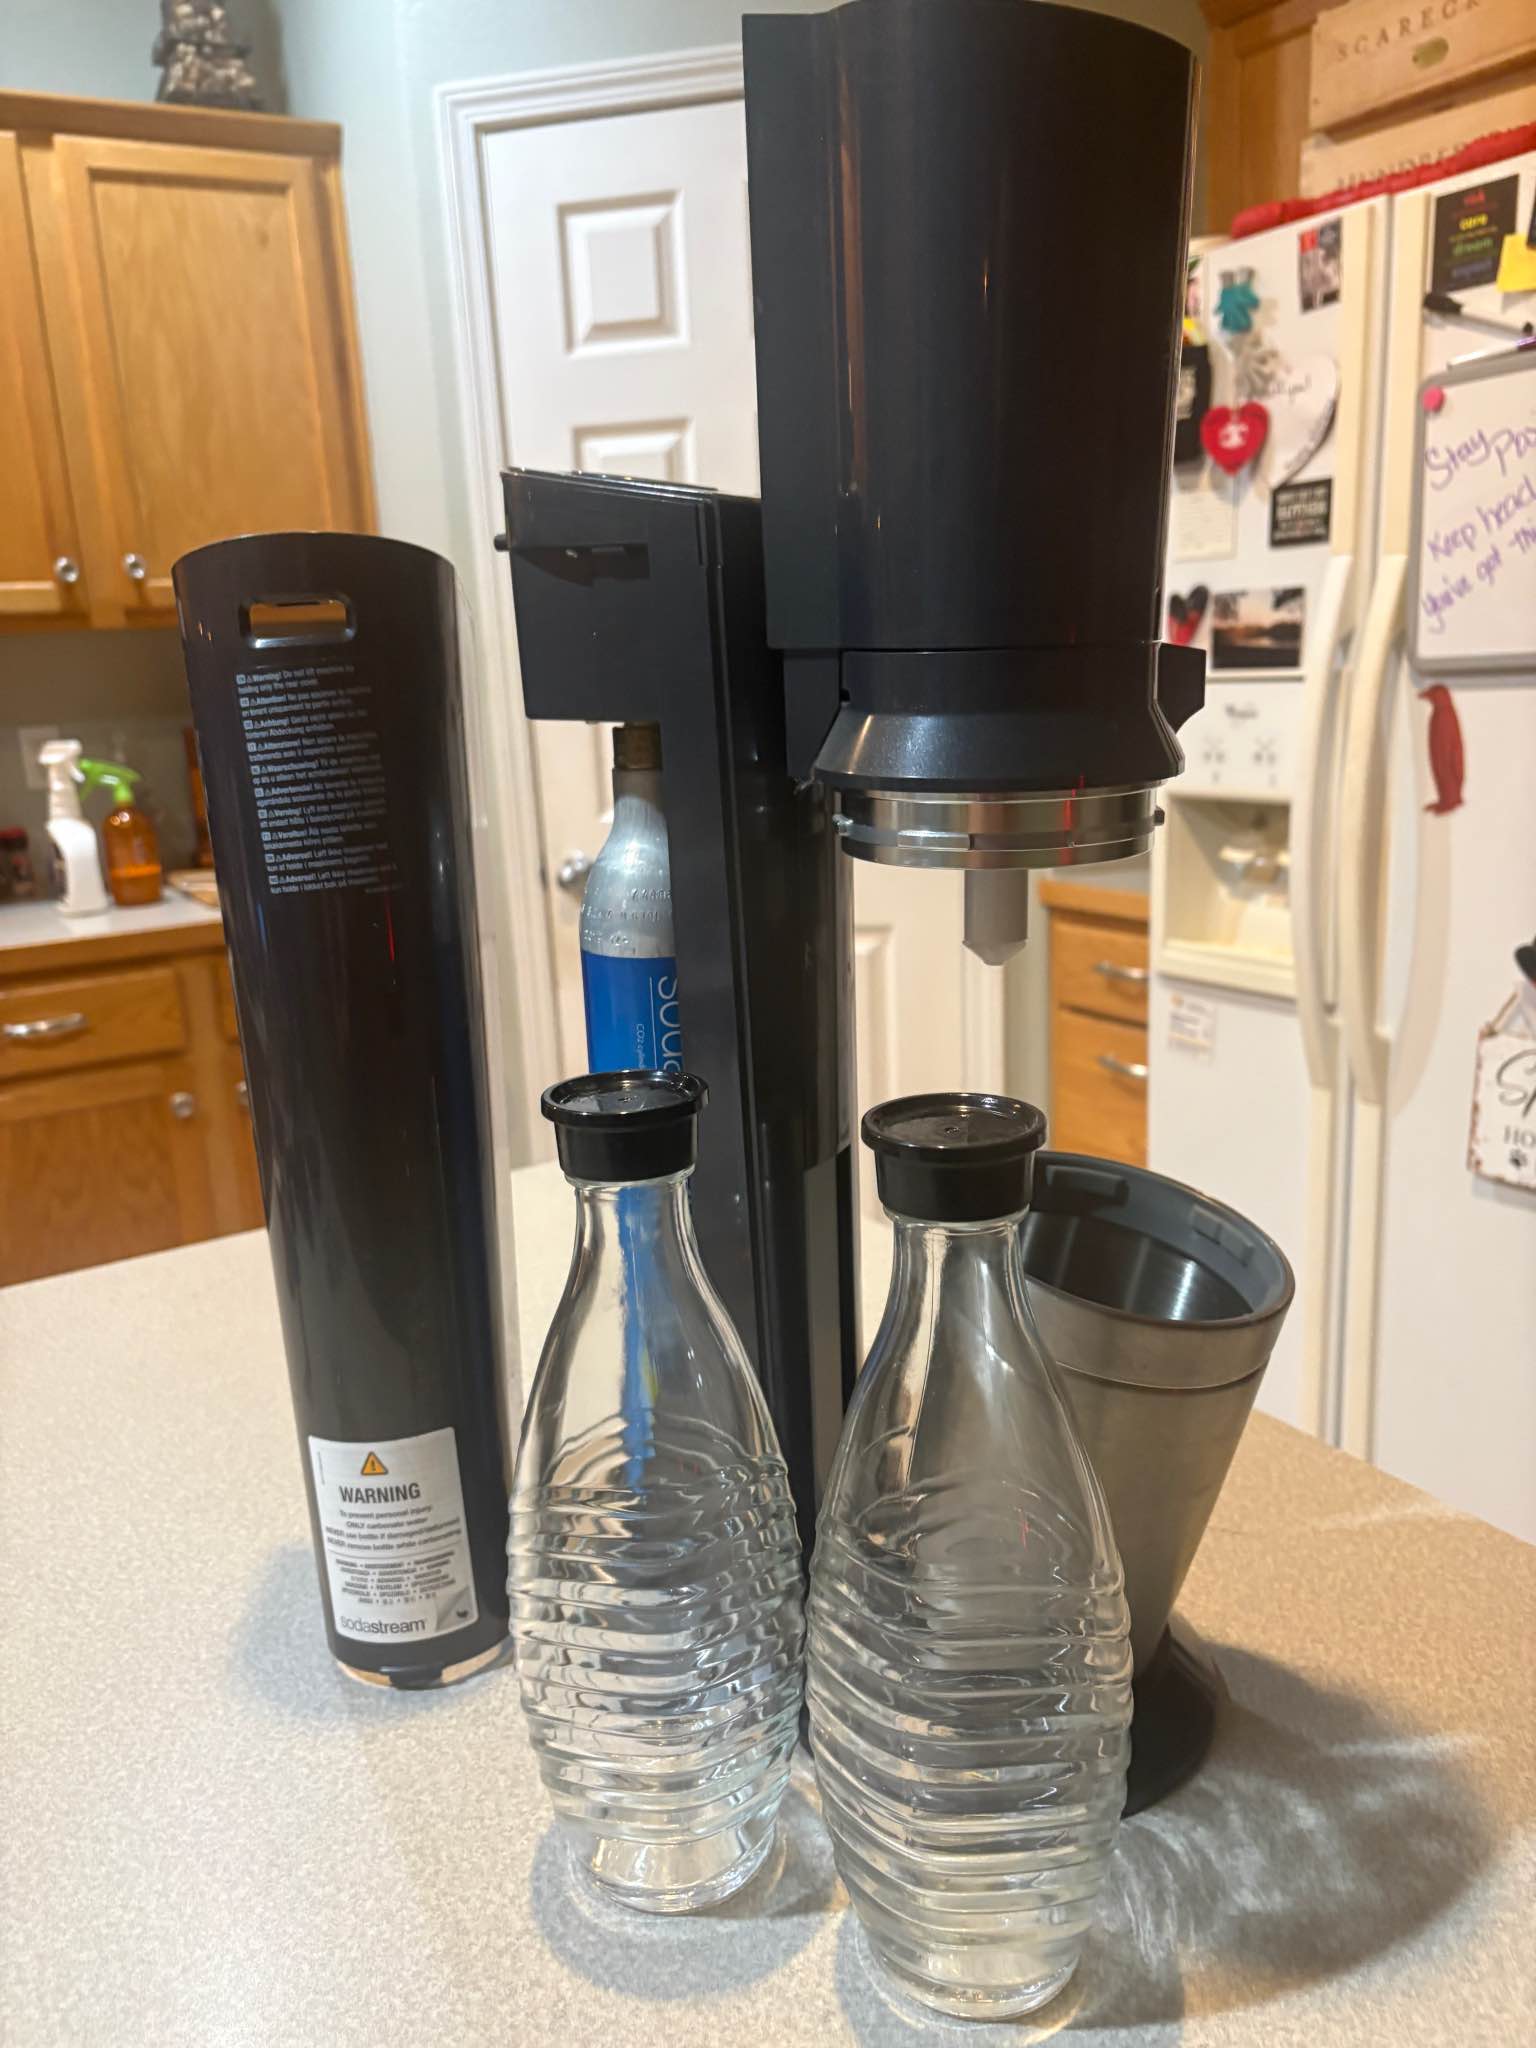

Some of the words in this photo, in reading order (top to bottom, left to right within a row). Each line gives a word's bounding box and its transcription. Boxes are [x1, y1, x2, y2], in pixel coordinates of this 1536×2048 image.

[338, 1482, 421, 1504] WARNING
[376, 1508, 409, 1520] personal
[346, 1521, 365, 1529] ONLY
[406, 1517, 428, 1526] water
[373, 1542, 394, 1551] bottle
[340, 1616, 426, 1634] sodastream
